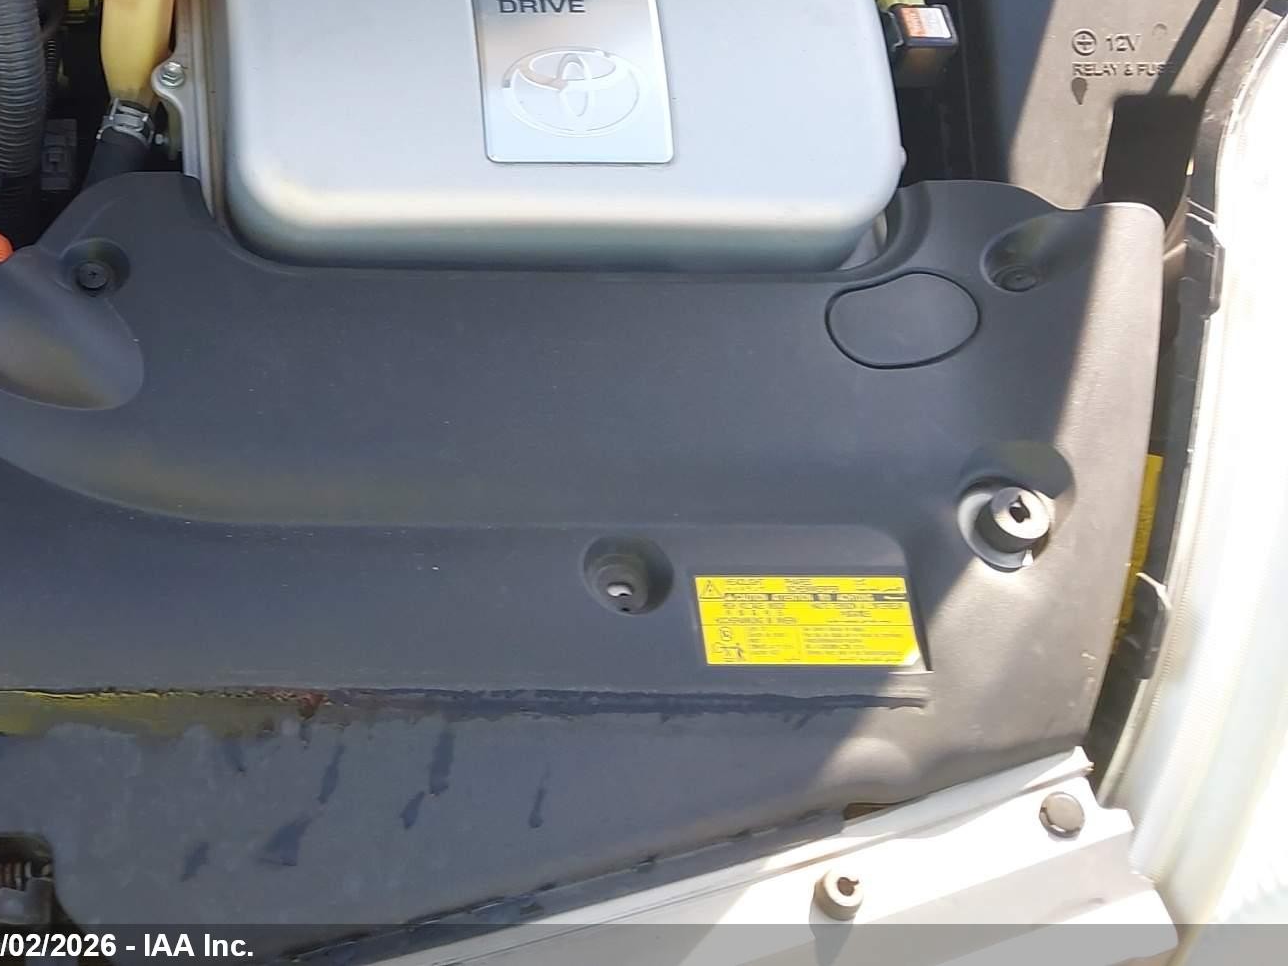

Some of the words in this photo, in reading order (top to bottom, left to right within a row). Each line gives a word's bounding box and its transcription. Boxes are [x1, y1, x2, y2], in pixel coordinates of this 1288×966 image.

[499, 0, 586, 13] DRIVE
[1104, 33, 1142, 52] 12V
[1071, 61, 1118, 77] RELAY
[1123, 61, 1134, 76] &
